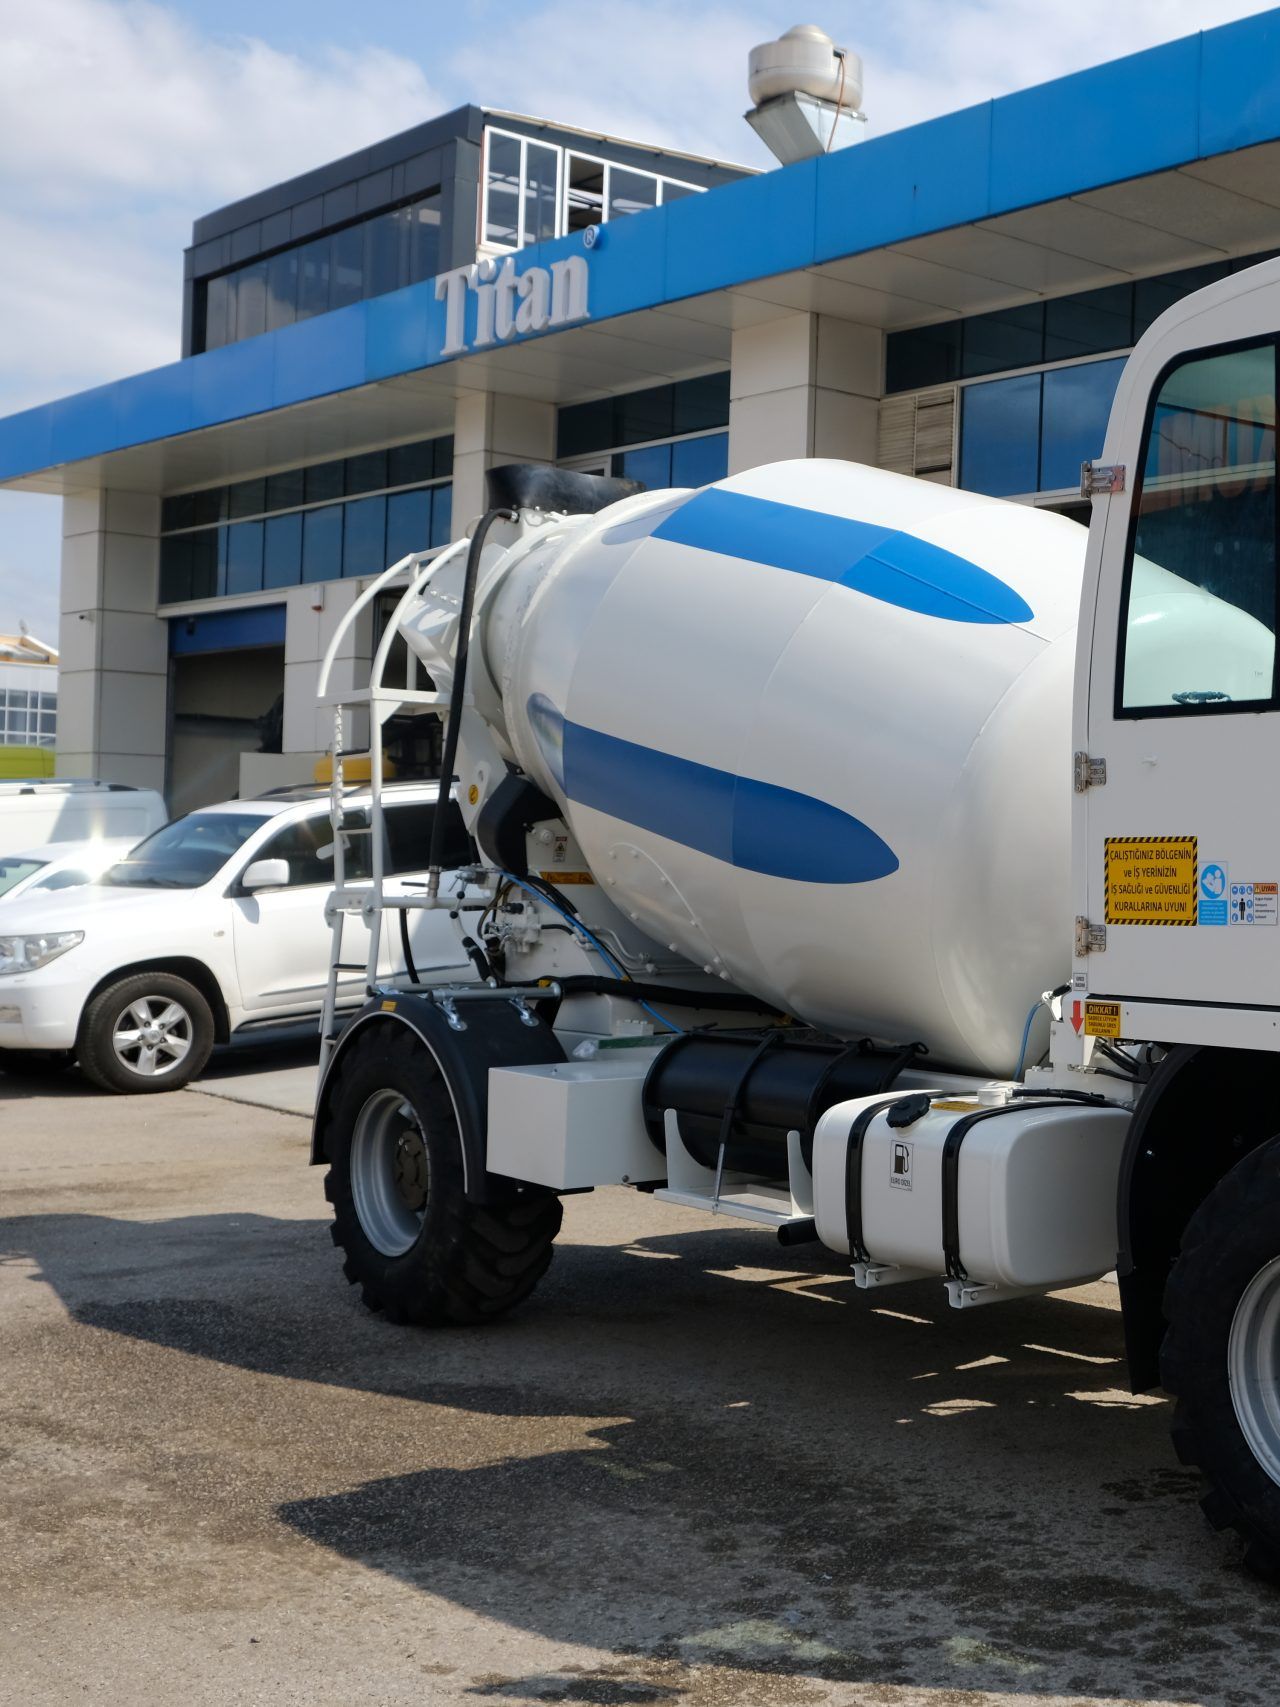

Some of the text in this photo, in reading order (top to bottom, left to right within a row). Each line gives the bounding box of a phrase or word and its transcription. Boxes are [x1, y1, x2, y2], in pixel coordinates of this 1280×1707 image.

[434, 255, 591, 356] Titan
[1110, 847, 1191, 862] ÇALIŞTIĞINIZ BÖLGENİN
[1124, 865, 1177, 879] ve İŞ YERİNİZİN
[1111, 882, 1190, 895] İŞ SAĞLIĞI ve GÜVENLİĞİ
[1114, 901, 1162, 912] KURALLARINA
[1088, 1005, 1112, 1014] DİKKAT
